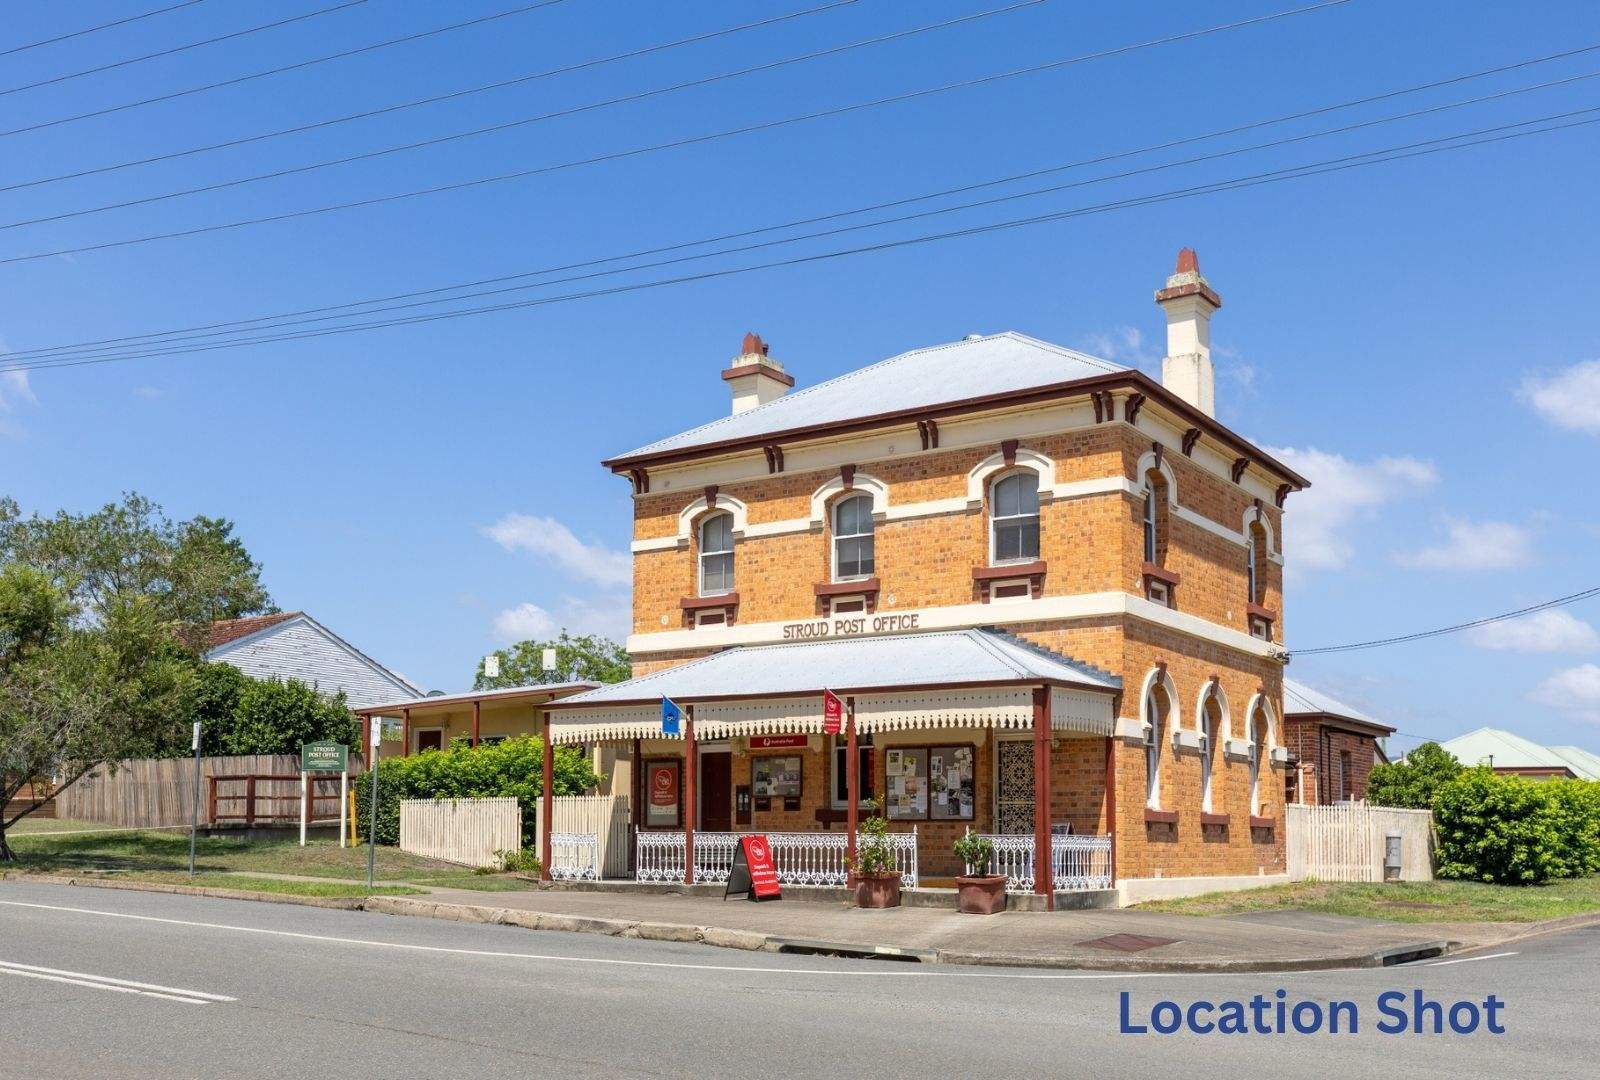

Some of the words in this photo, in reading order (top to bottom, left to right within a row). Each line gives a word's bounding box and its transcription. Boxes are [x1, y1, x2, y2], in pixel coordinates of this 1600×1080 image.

[783, 621, 829, 639] STROUD
[835, 618, 866, 635] POST
[873, 614, 919, 632] OFFICE
